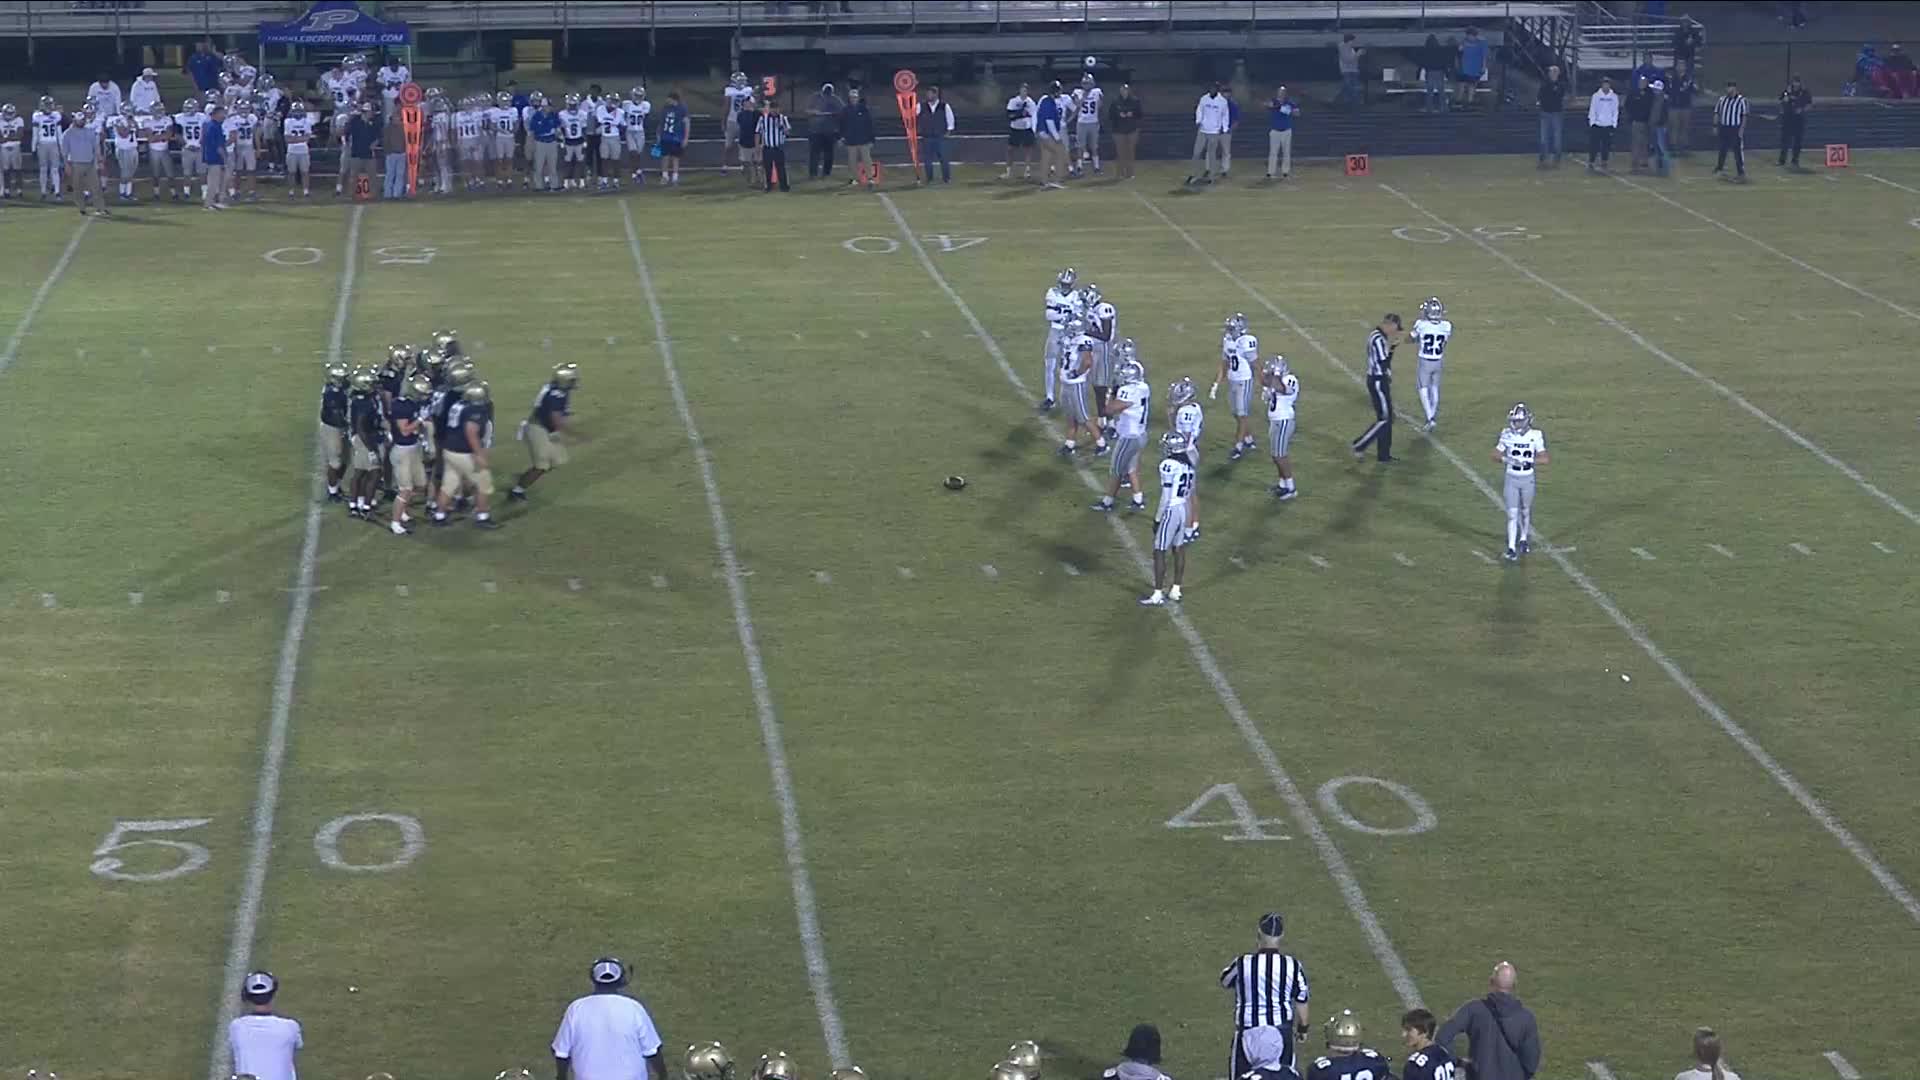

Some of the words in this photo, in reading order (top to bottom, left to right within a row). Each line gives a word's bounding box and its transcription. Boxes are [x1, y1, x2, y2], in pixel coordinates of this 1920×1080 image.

[301, 9, 360, 32] P
[763, 76, 776, 96] 3
[1350, 157, 1366, 171] 30
[1831, 147, 1845, 161] 20
[1423, 334, 1445, 355] 23
